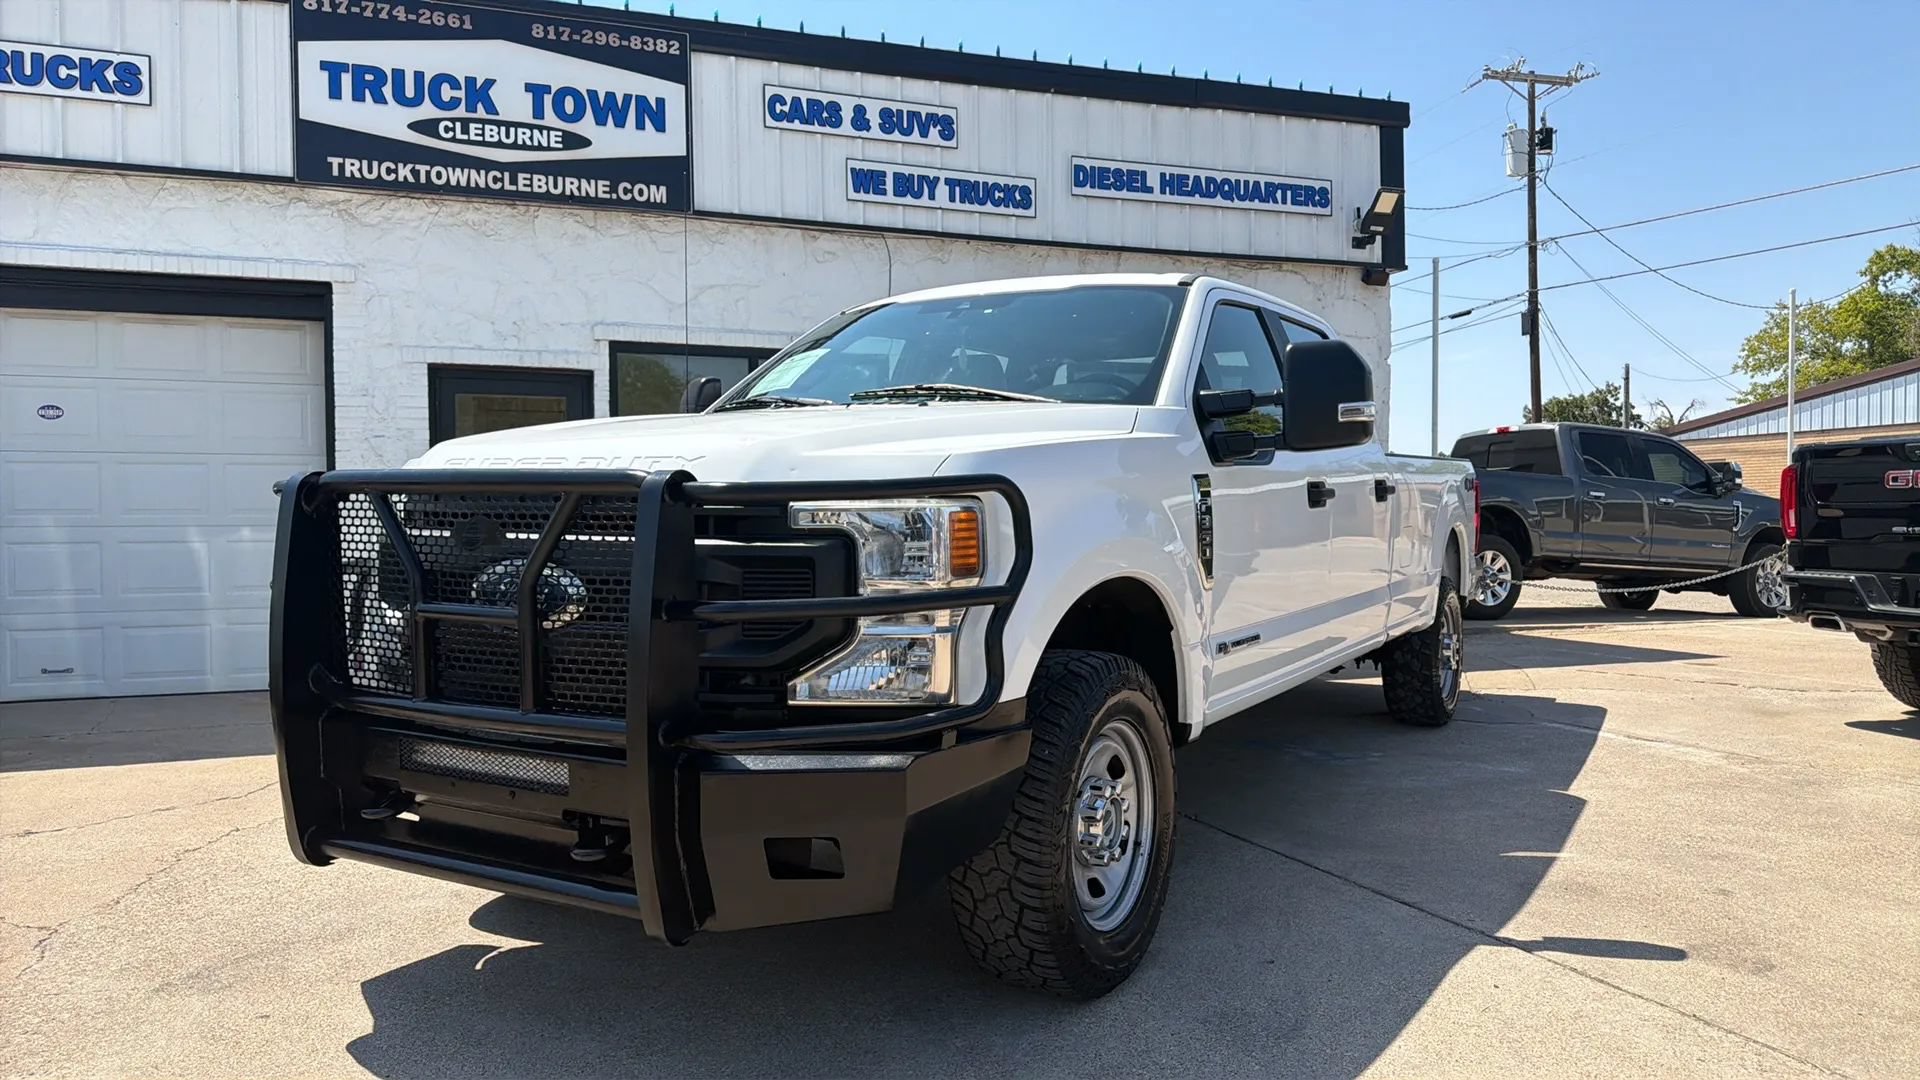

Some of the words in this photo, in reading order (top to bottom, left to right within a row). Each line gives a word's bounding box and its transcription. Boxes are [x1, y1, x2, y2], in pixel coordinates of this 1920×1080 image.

[303, 0, 473, 30] 817-774-2661
[531, 23, 681, 55] 817-296-8382
[319, 60, 500, 116] TRUCK
[524, 82, 667, 133] TOWN
[767, 93, 843, 129] CARS
[850, 104, 872, 133] &
[878, 107, 956, 142] SUV'S
[438, 120, 564, 149] CLEBURNE
[327, 156, 667, 204] TRUCKTOWNCLEBURNE.COM
[850, 167, 888, 196] WE
[892, 172, 941, 200] BUY
[944, 177, 1033, 210] TRUCKS
[1073, 163, 1154, 194] DIESEL
[1159, 172, 1331, 209] HEADQUARTERS
